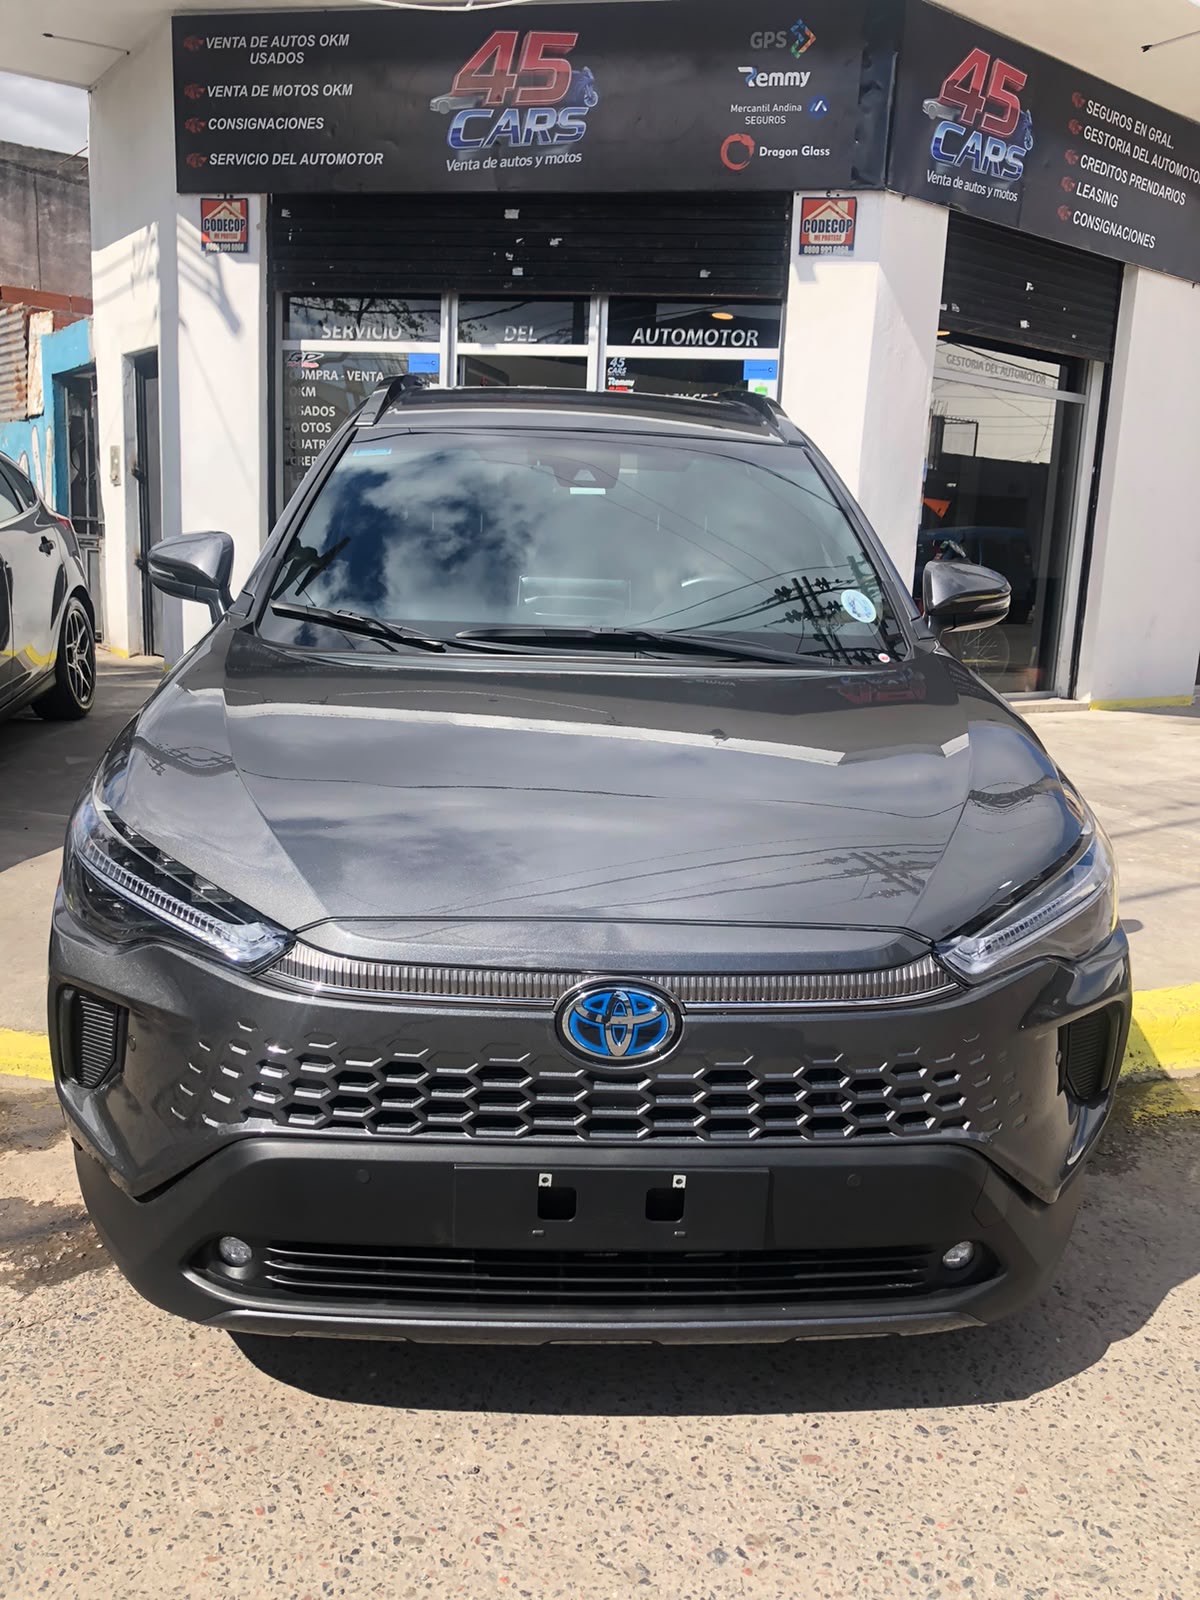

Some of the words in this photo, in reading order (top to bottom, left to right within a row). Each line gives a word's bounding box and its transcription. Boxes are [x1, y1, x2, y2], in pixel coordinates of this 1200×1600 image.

[205, 36, 247, 49] VENTA
[250, 35, 269, 48] DE
[270, 34, 316, 48] AUTOS
[750, 31, 788, 49] GPS
[250, 51, 304, 65] USADOS
[452, 30, 579, 107] 45
[737, 66, 811, 88] Remmy
[207, 85, 248, 98] VENTA
[251, 84, 269, 97] DE
[272, 84, 319, 97] MOTOS
[939, 47, 1028, 138] 45
[730, 104, 771, 113] Mercantil
[772, 103, 802, 112] Andina
[208, 117, 324, 130] CONSIGNACIONES
[447, 107, 590, 150] CARS
[745, 115, 786, 125] SEGUROS
[1086, 99, 1133, 131] SEGUROS
[1133, 121, 1148, 137] EN
[1148, 126, 1175, 150] GRAL.
[759, 146, 798, 159] Dragon
[801, 145, 831, 157] Glass
[930, 120, 1027, 181] CARS
[1083, 125, 1131, 157] GESTORIA
[1132, 145, 1150, 164] DEL
[209, 153, 270, 166] SERVICIO
[272, 153, 297, 165] DEL
[299, 152, 384, 165] AUTOMOTOR
[446, 159, 480, 172] Venta
[482, 156, 498, 169] de
[499, 155, 533, 169] autos
[534, 155, 544, 168] y
[544, 152, 583, 165] motos
[926, 169, 951, 187] Venta
[952, 176, 964, 190] de
[963, 179, 987, 196] autos
[987, 186, 993, 199] y
[993, 187, 1019, 202] motos
[1080, 154, 1128, 184] CREDITOS
[1128, 172, 1187, 206] PRENDARIOS
[1076, 181, 1119, 208] LEASING
[204, 218, 246, 232] CODECOP
[804, 218, 852, 234] CODECOP
[1072, 210, 1156, 249] CONSIGNACIONES
[321, 324, 402, 340] SERVICIO
[503, 325, 538, 342] DEL
[631, 327, 759, 347] AUTOMOTOR
[347, 370, 384, 382] VENTA
[946, 354, 984, 370] GESTORIA
[984, 362, 1000, 375] DEL
[999, 366, 1047, 385] AUTOMOTOR
